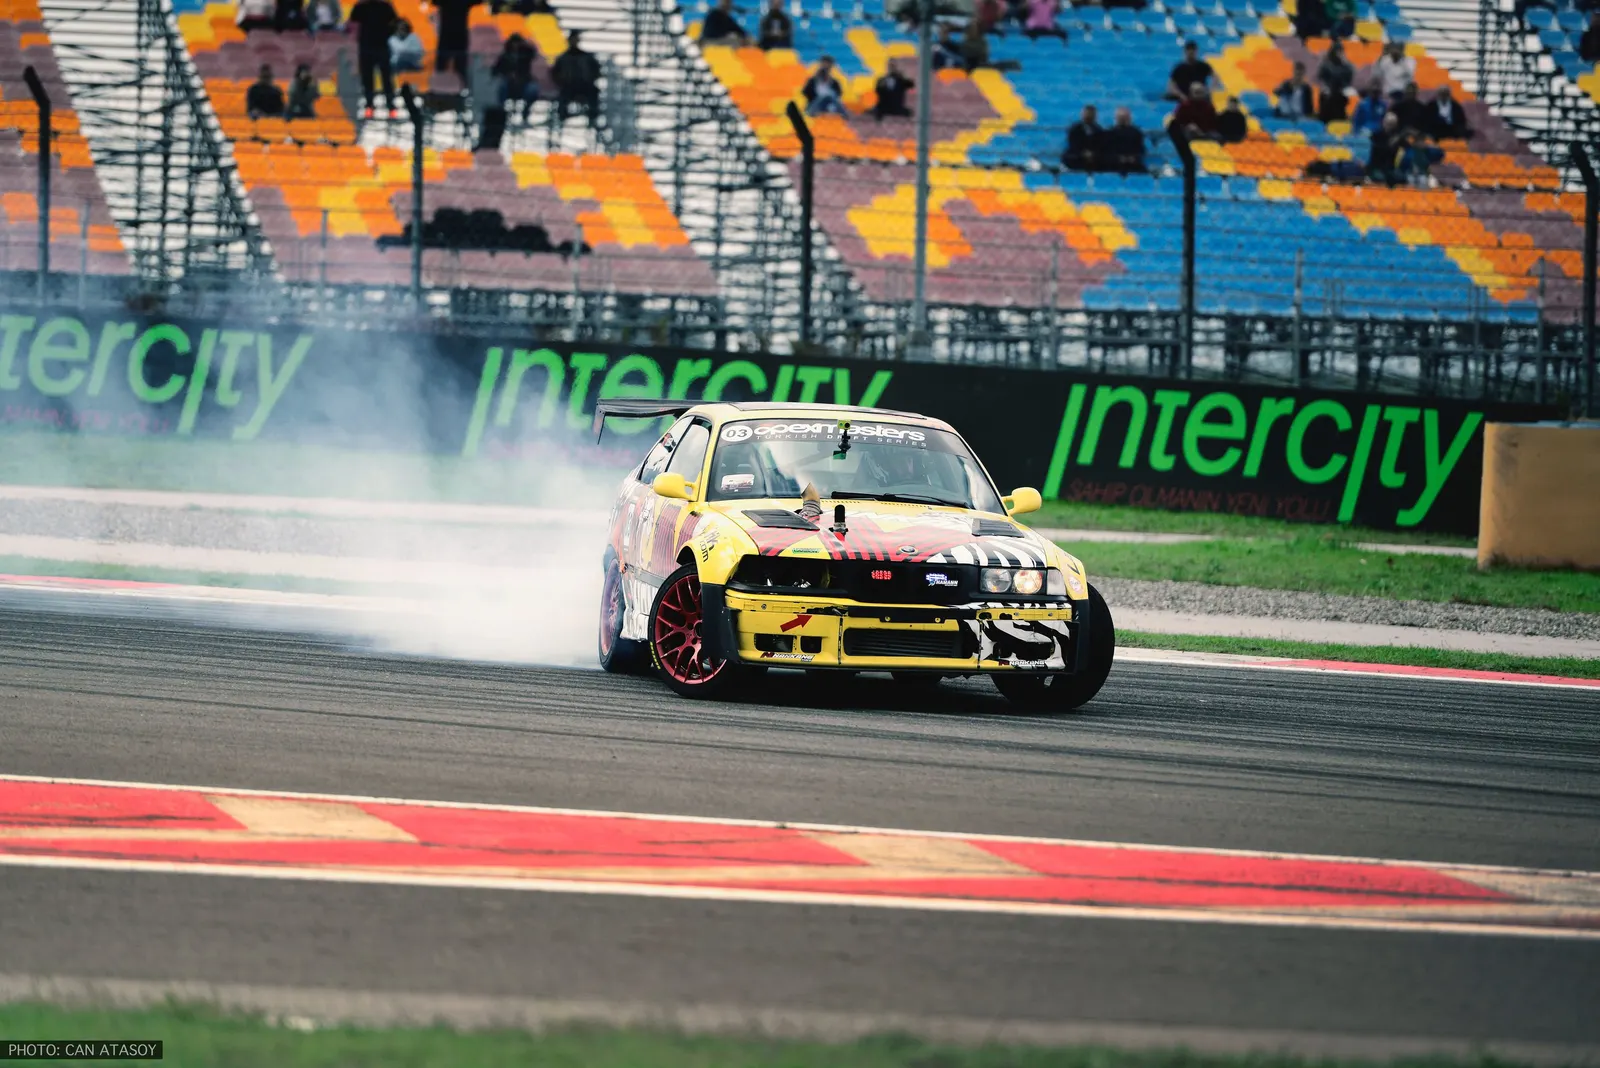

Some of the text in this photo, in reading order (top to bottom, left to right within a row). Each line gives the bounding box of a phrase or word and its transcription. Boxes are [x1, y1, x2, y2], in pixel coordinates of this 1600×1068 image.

[726, 429, 748, 438] 03
[877, 437, 927, 447] SERIES
[1042, 383, 1484, 526] intercity
